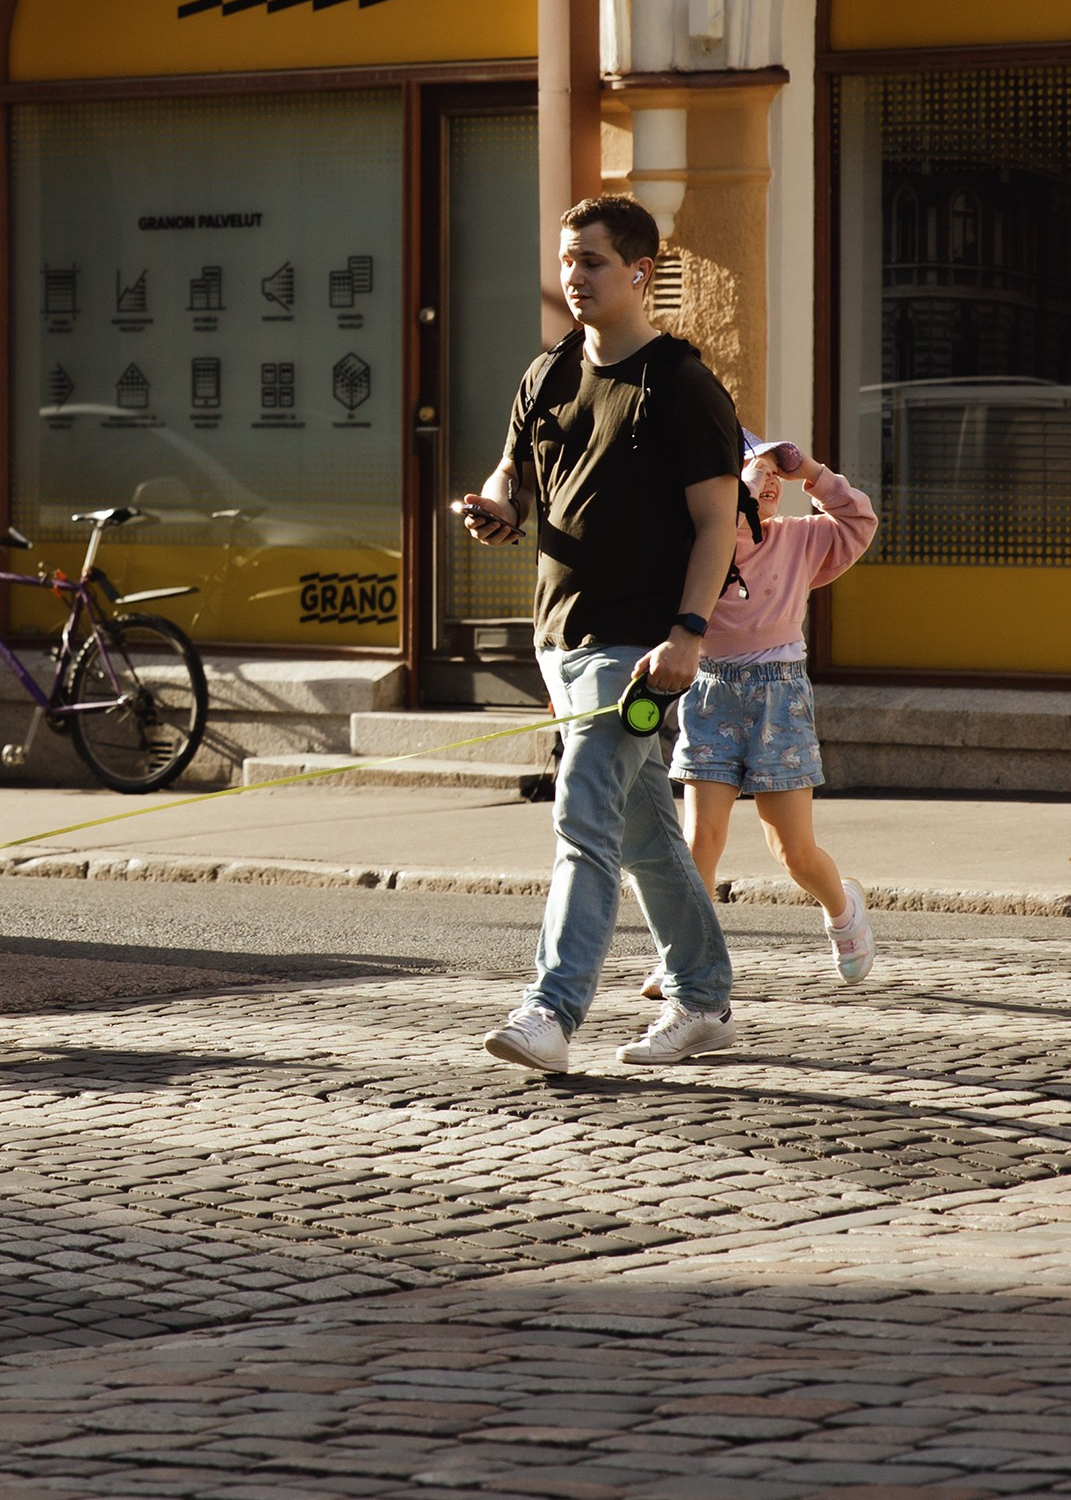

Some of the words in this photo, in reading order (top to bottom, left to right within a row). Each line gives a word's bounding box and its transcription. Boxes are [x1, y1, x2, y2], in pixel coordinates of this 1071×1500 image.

[138, 215, 195, 231] GRANON
[198, 213, 263, 229] PALVELUT
[300, 584, 397, 613] GRANO
